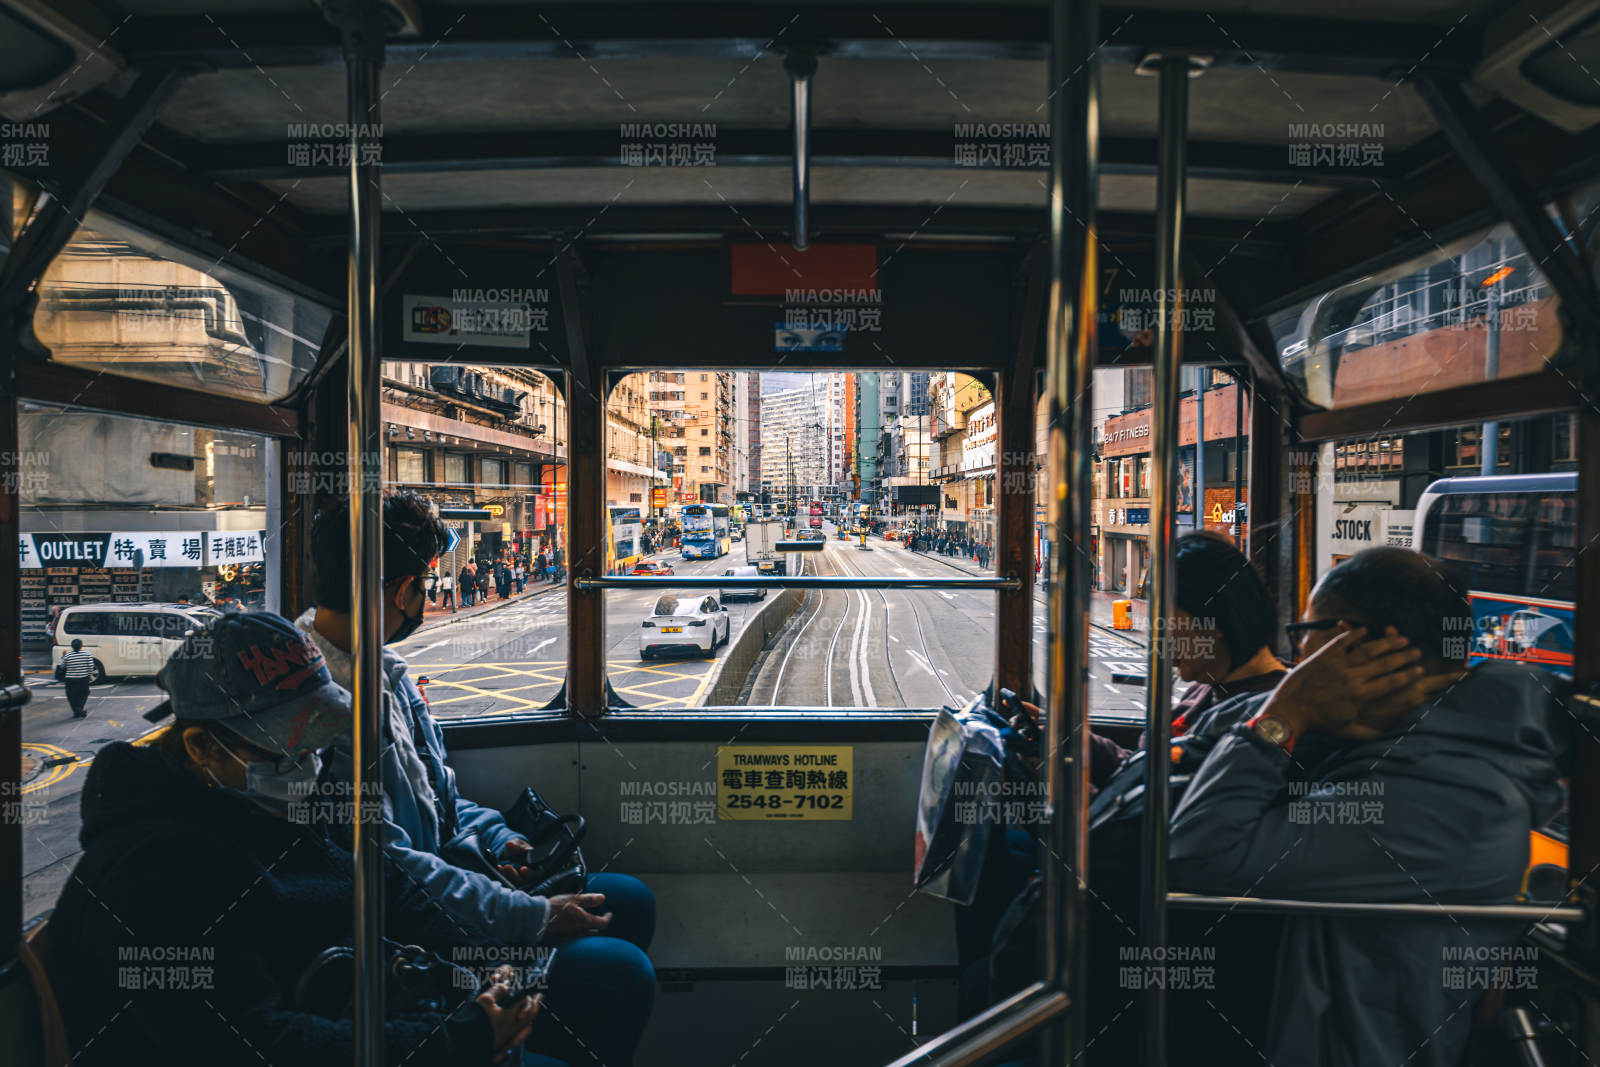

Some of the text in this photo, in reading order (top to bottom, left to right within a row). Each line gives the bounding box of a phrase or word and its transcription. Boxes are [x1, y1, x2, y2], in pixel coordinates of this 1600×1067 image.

[1104, 424, 1149, 444] 24/7 FITNESS
[41, 540, 103, 560] OUTLET
[115, 538, 201, 561] 特賣場
[212, 536, 259, 559] 手機配件
[733, 754, 838, 766] TRAMWAYS HOTLINE
[722, 769, 848, 790] 電車查詢熱線
[727, 794, 844, 809] 2548-7102
